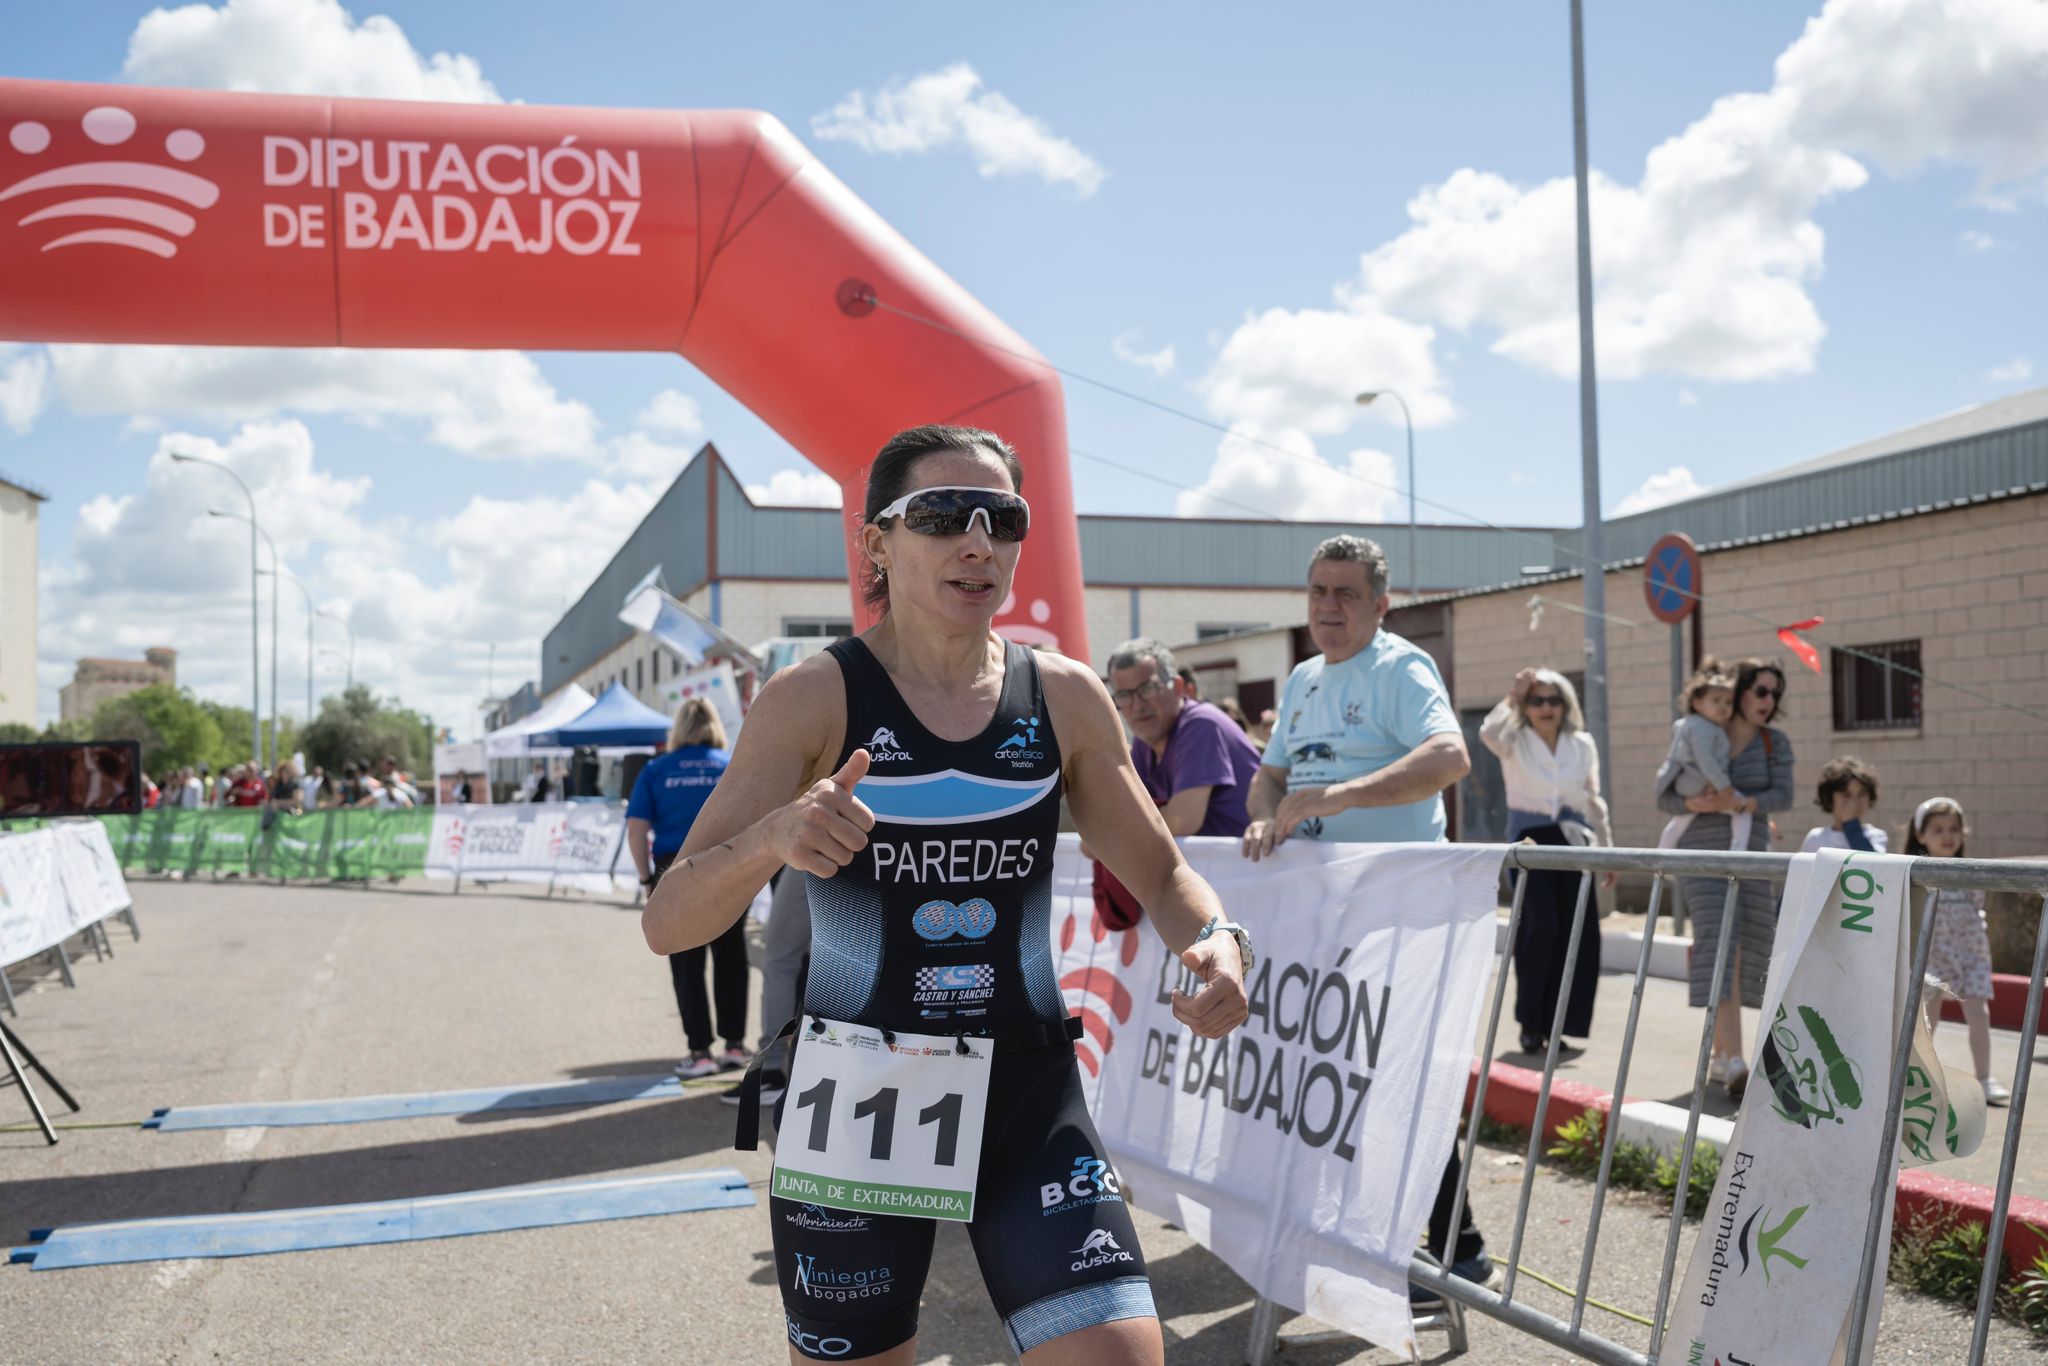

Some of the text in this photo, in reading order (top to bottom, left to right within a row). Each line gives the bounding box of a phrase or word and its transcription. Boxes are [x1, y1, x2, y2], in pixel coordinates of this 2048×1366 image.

[263, 136, 641, 197] DIPUTACIÓN
[263, 192, 641, 256] DE BADAJOZ
[869, 751, 914, 762] ustral
[872, 838, 1039, 884] PAREDES
[913, 988, 995, 1002] CASTRO Y SÁNCHEZ
[1156, 947, 1391, 1069] DACIÓN
[1141, 1028, 1373, 1162] DE BADAJOZ
[796, 1077, 963, 1167] 111
[779, 1174, 965, 1212] JUNTA DE EXTREMADURA
[1699, 1151, 1755, 1308] Extremadura
[795, 1252, 890, 1287] Viniegra
[1071, 1251, 1134, 1272] austral
